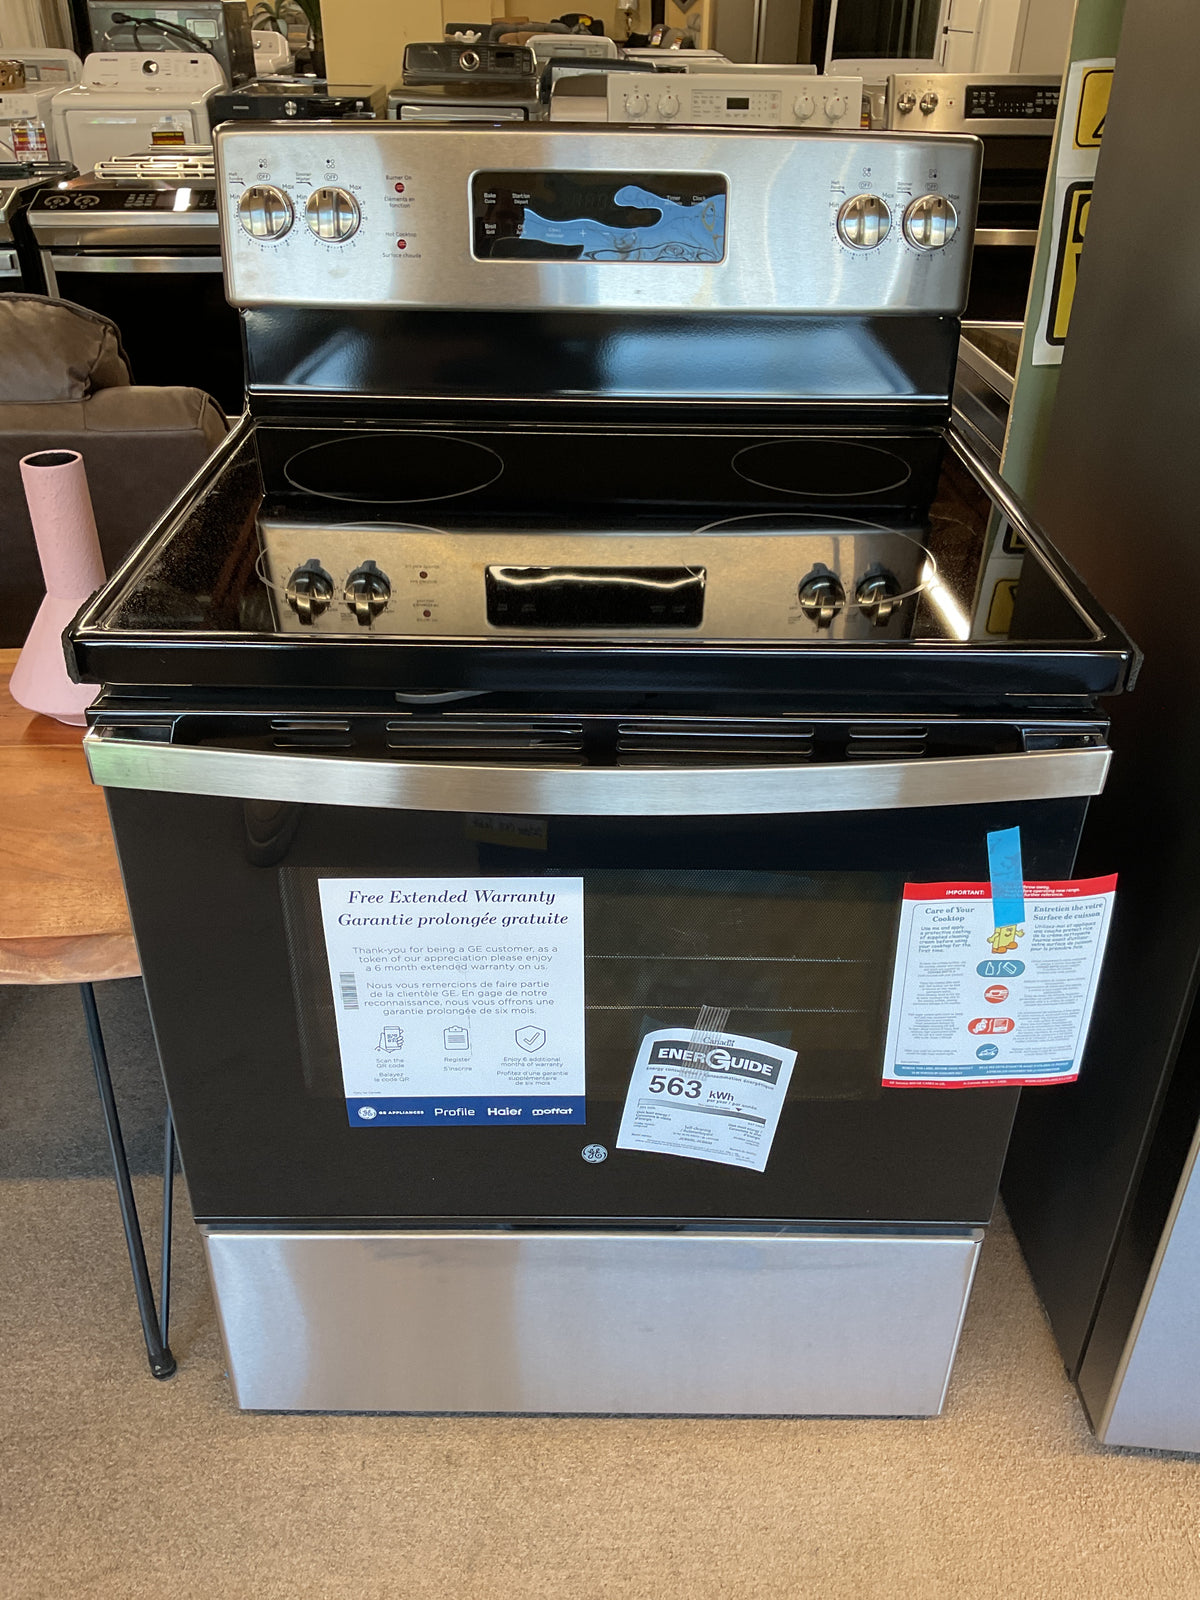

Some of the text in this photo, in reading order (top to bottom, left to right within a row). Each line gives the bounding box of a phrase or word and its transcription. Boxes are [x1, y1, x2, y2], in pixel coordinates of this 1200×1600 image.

[348, 890, 556, 905] Free Extended Warranty
[338, 912, 569, 928] Garantie prolongée gratuite
[352, 946, 406, 954] Thank-you
[427, 946, 456, 954] being
[424, 955, 488, 963] appreciation
[490, 954, 523, 963] please
[470, 963, 515, 972] warranty
[520, 981, 550, 989] partie
[383, 1008, 424, 1016] garantie
[426, 1007, 477, 1016] prolongée
[703, 1036, 736, 1047] Canada
[658, 1048, 774, 1076] ENERGUIDE
[648, 1075, 735, 1102] 563 kWh
[434, 1107, 476, 1116] Profile
[487, 1107, 522, 1116] Haier
[532, 1107, 573, 1116] moffat
